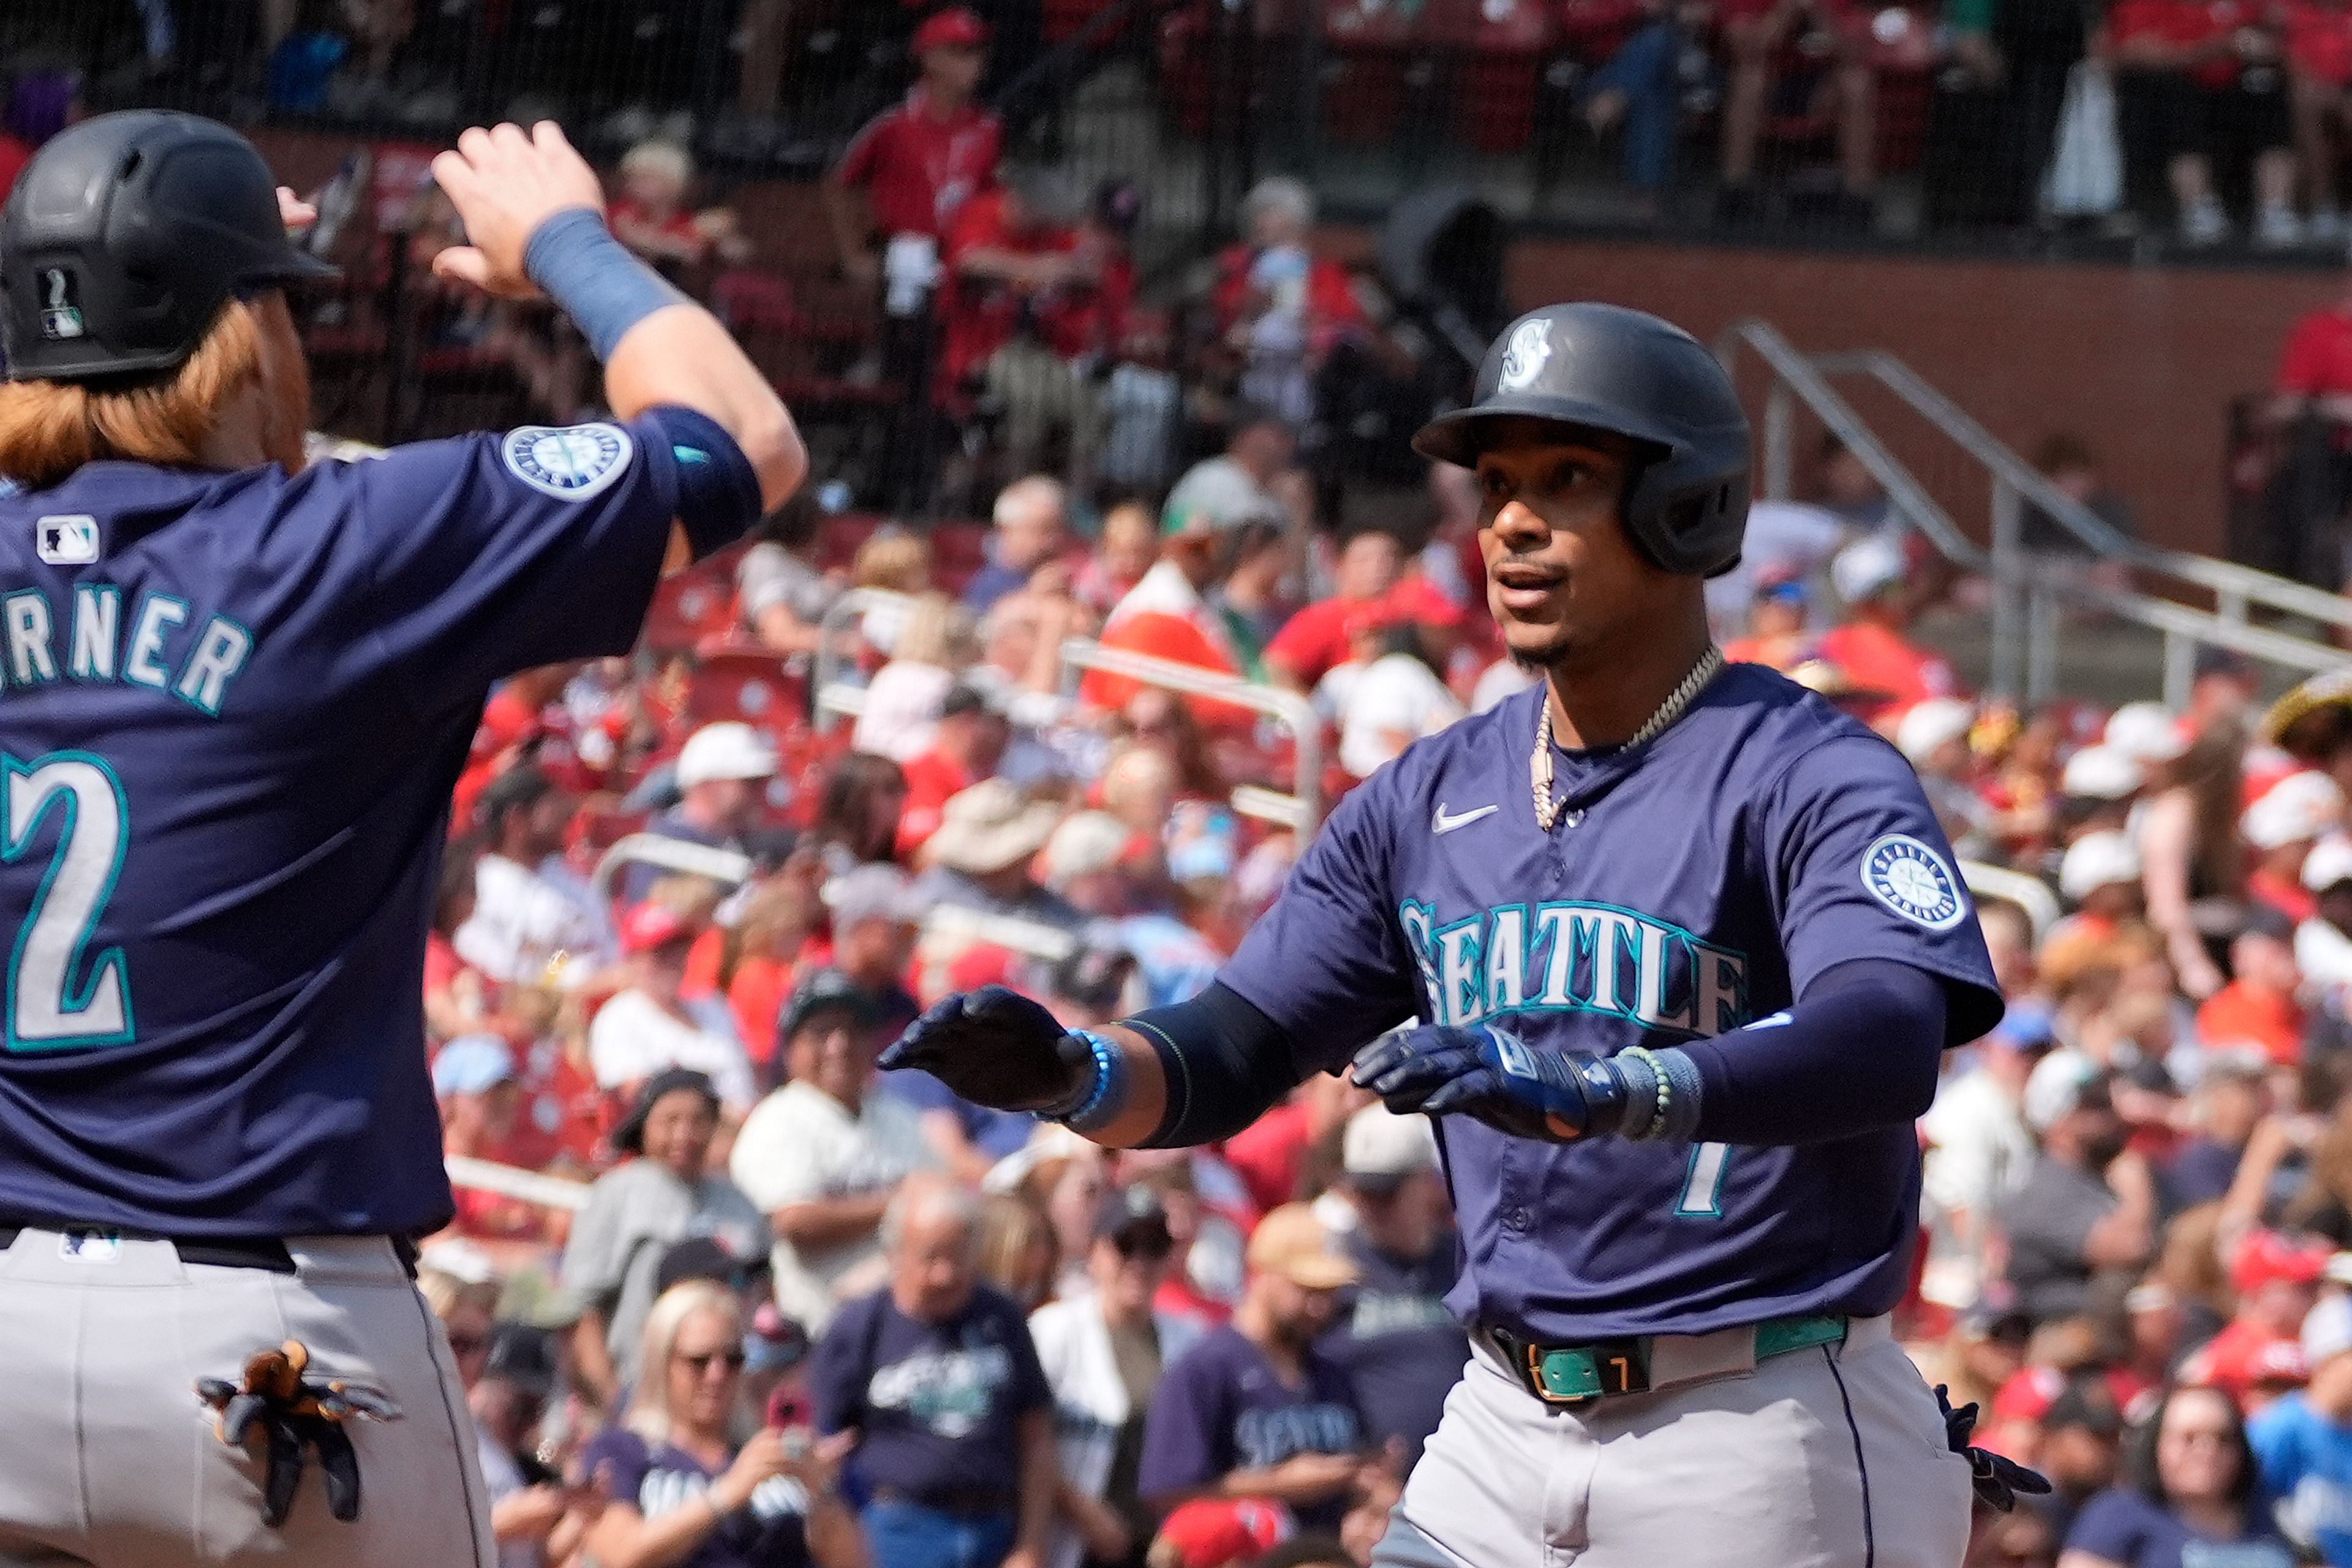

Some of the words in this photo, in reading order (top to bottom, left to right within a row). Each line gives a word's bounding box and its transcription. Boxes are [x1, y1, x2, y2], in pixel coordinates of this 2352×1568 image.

[1498, 318, 1554, 394] S
[0, 582, 254, 718] RNER
[0, 749, 135, 1051] 2
[1398, 898, 1750, 1040] SEATTLE
[1610, 1356, 1629, 1392] 7
